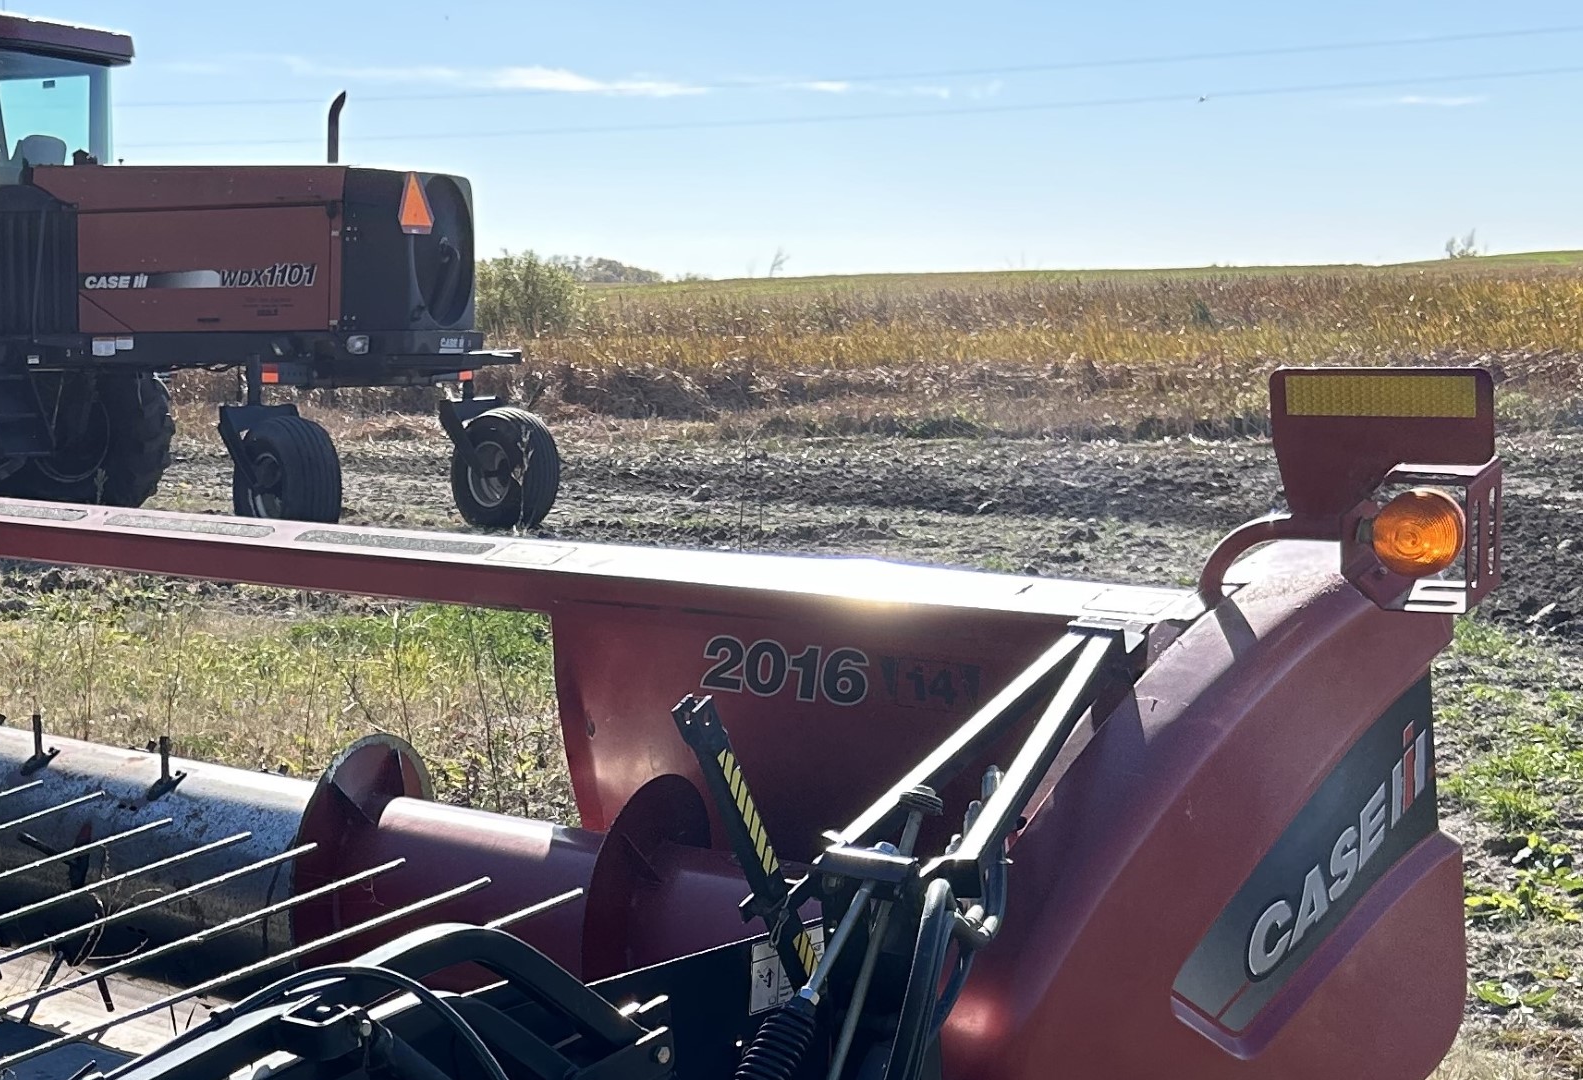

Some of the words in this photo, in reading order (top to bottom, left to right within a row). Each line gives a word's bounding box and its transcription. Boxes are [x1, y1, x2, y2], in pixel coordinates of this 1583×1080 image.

[84, 276, 130, 289] CASE
[220, 263, 317, 288] WDX1101
[699, 634, 870, 706] 2016
[1248, 781, 1386, 976] CASE
